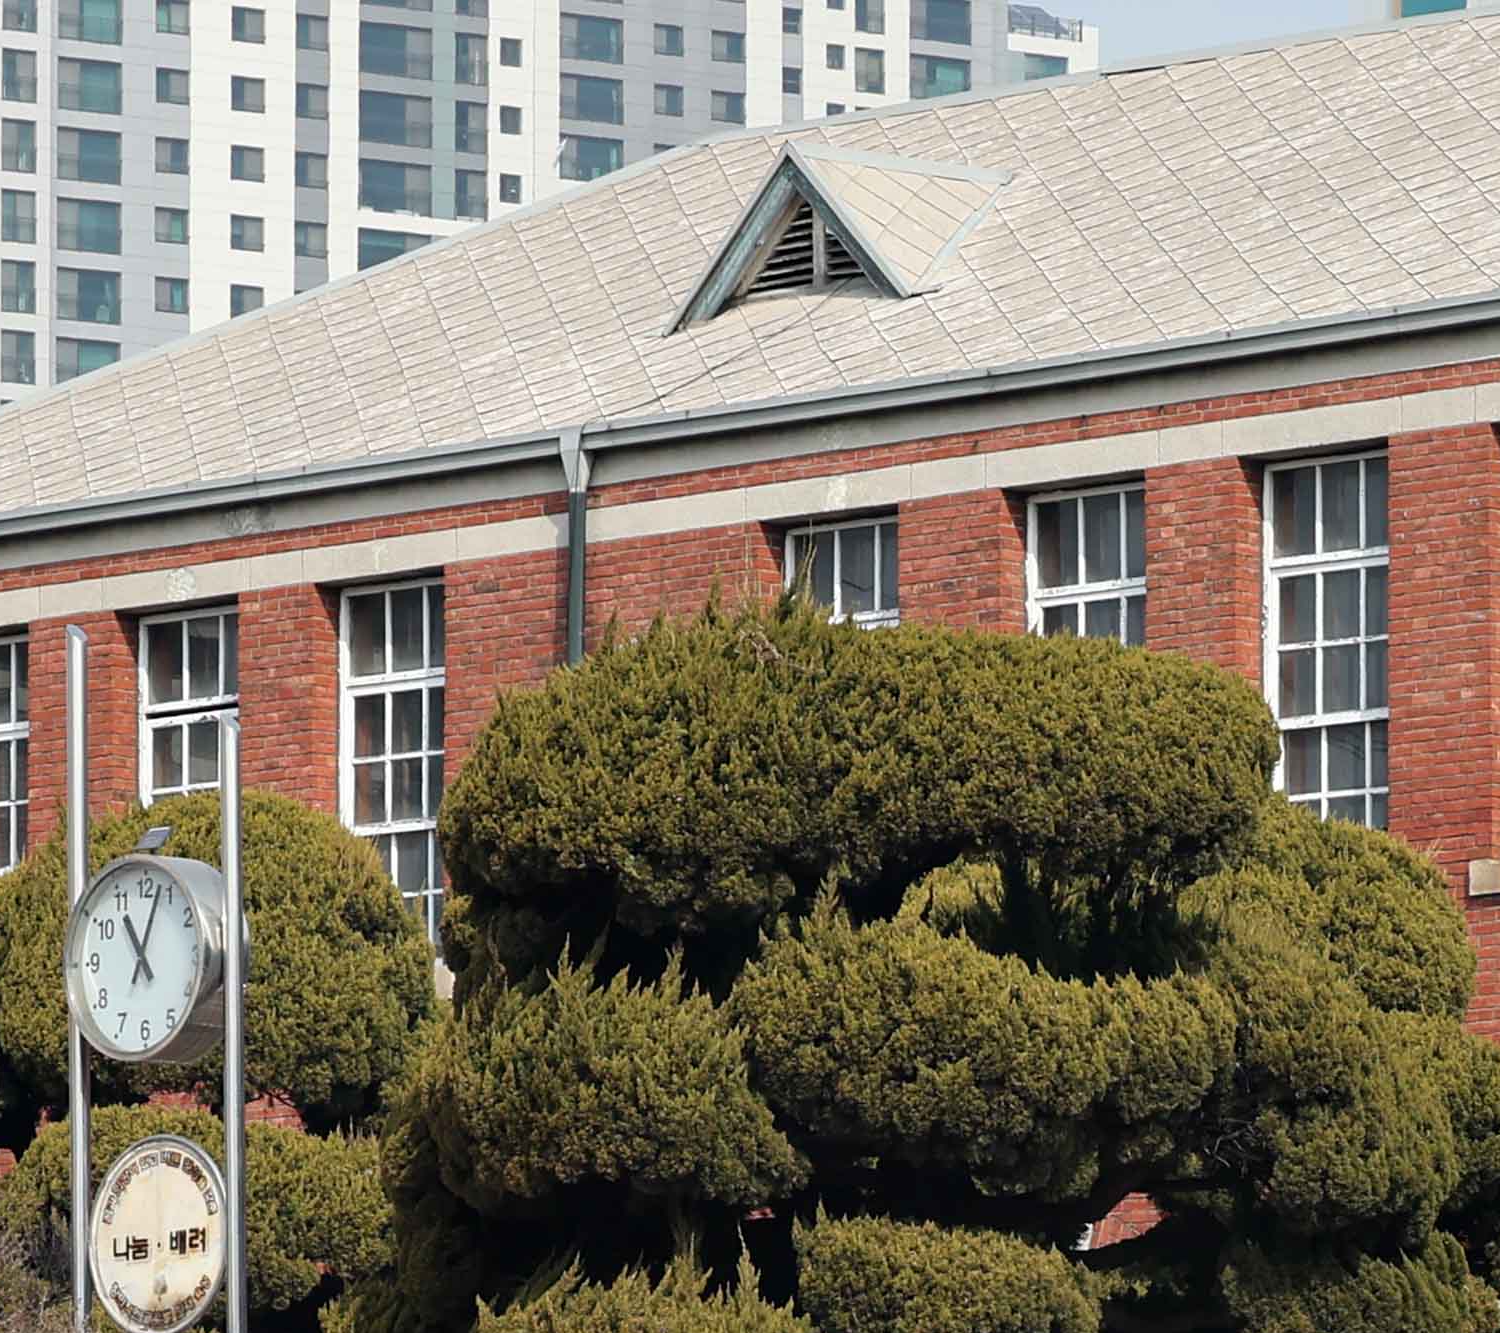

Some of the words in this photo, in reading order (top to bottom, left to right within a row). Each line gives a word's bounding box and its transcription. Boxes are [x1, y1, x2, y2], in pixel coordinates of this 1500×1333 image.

[138, 878, 153, 899] 12
[166, 884, 173, 905] 1
[115, 891, 128, 912] 11
[184, 907, 193, 928] 2
[98, 919, 114, 940] 10
[90, 953, 100, 973] 9
[98, 988, 108, 1009] 8
[117, 1013, 127, 1033] 7
[166, 1009, 175, 1029] 5
[141, 1020, 150, 1041] 6
[113, 1235, 149, 1262] 나눔
[169, 1228, 208, 1255] 배려
